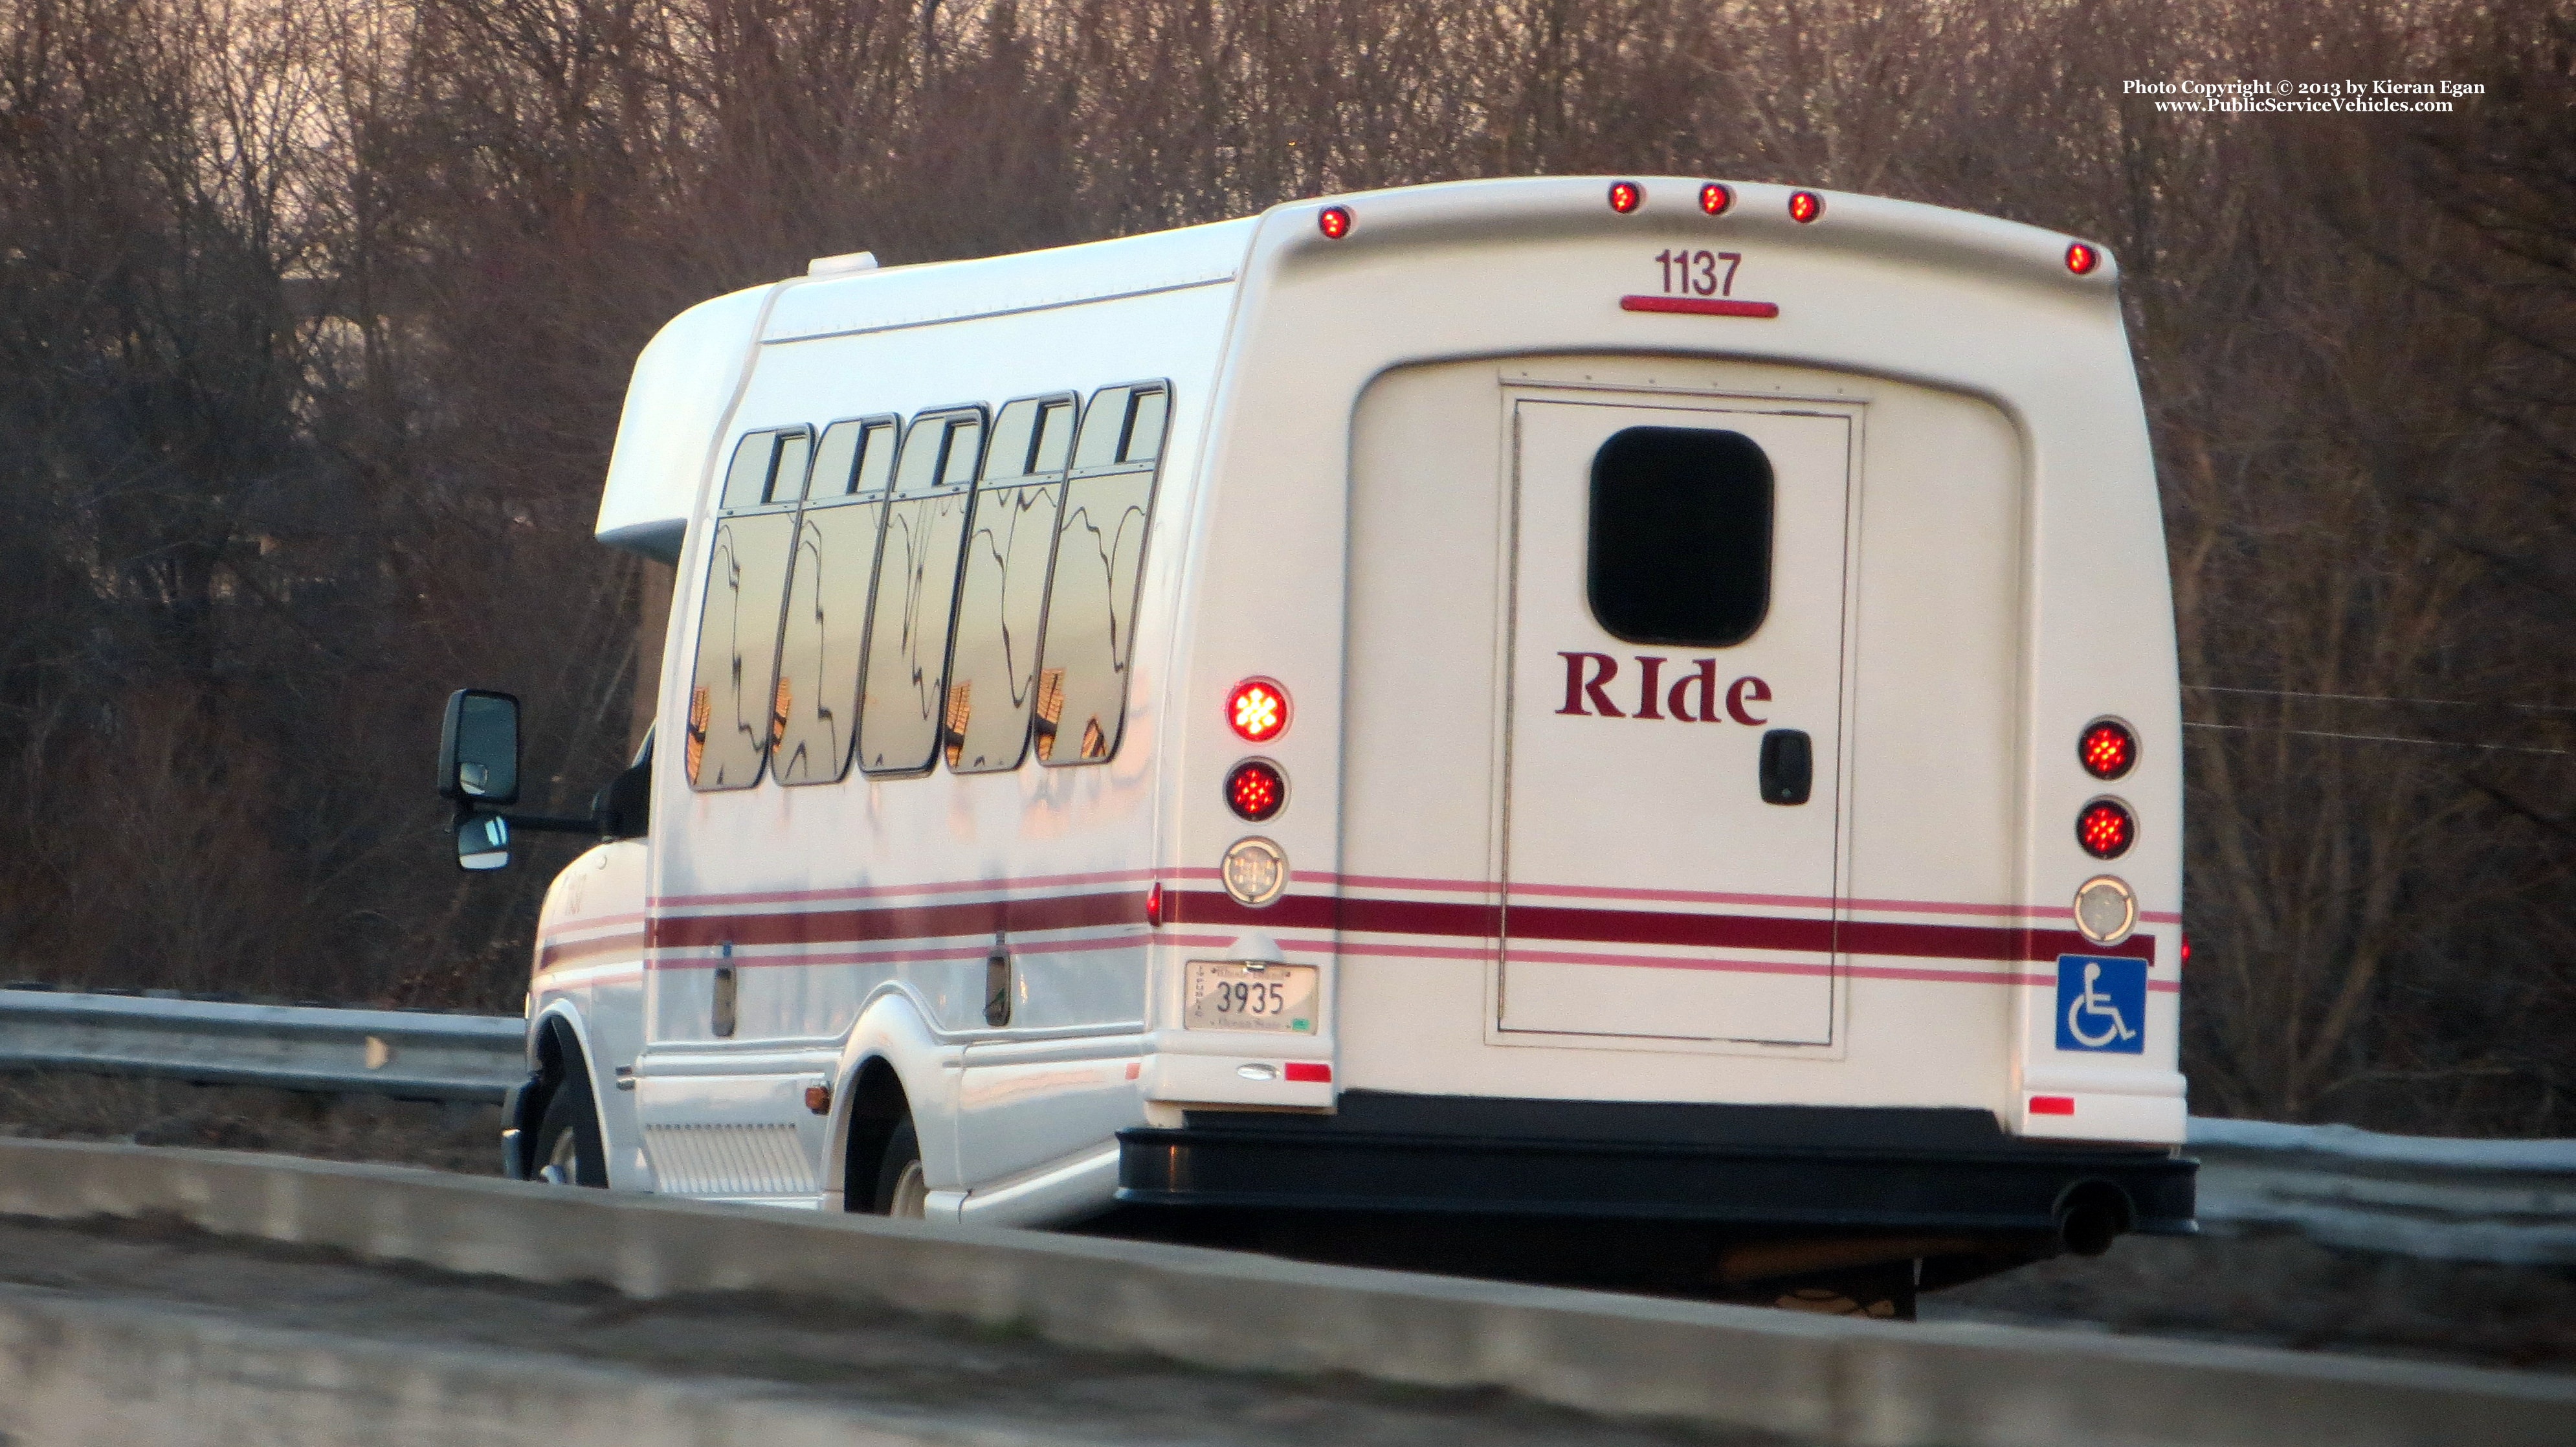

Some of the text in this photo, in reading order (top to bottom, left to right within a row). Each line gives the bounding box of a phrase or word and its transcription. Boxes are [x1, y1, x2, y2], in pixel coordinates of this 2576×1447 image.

[1654, 249, 1742, 297] 1137
[1555, 651, 1773, 726] RIde
[1217, 981, 1284, 1015] 3935
